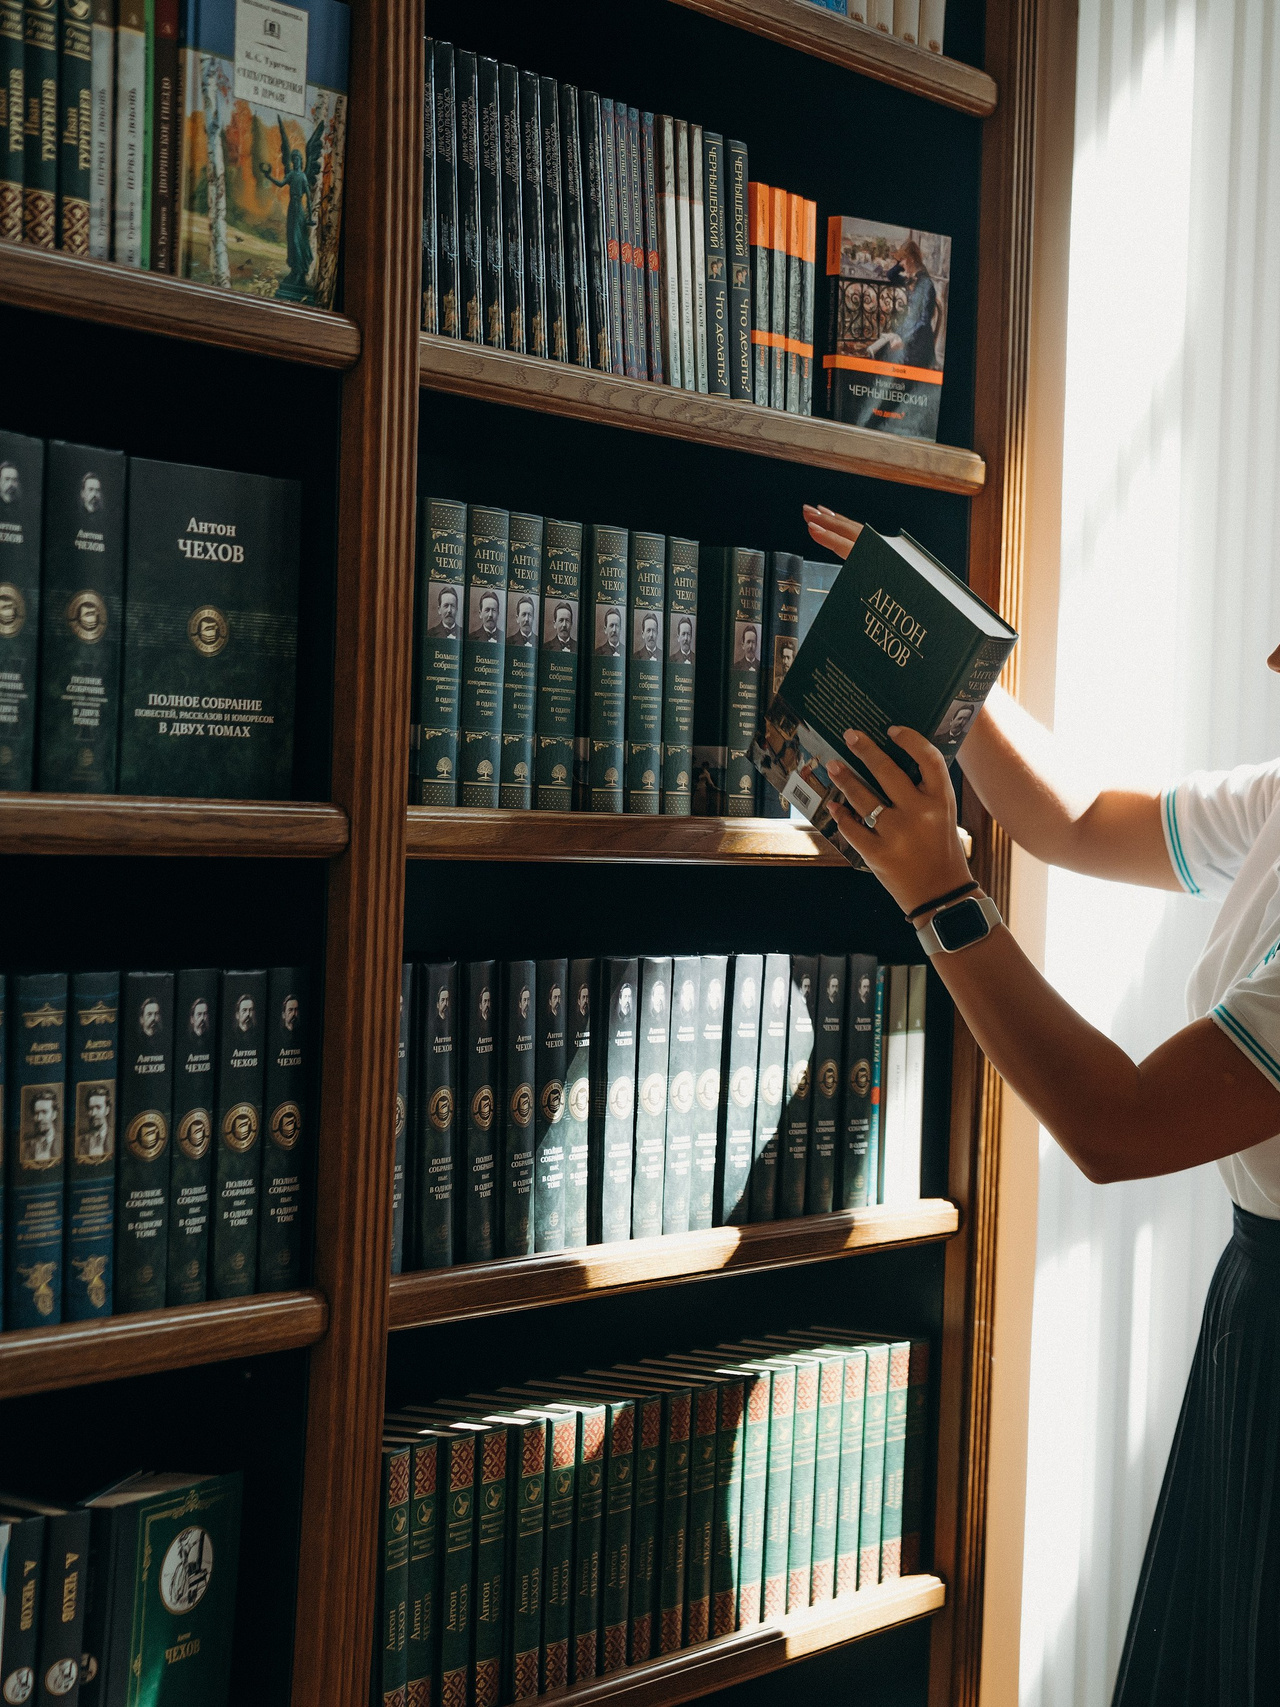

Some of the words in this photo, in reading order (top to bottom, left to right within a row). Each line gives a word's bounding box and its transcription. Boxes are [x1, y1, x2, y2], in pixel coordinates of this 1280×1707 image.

[9, 67, 24, 152] ТУРГЕНЕВ
[41, 77, 56, 162] ТУРГЕНЕВ
[708, 146, 720, 248] ЧЕРНЫШЕВСКИЙ
[734, 156, 744, 257] ЧЕРНЫШЕВСКИЙ
[715, 290, 726, 320] Что
[740, 299, 749, 326] Что
[715, 323, 728, 388] делать?
[740, 329, 751, 394] делать?
[848, 384, 928, 407] ЧЕРНЫШЕВСКИЙ
[876, 378, 906, 391] Николай
[186, 517, 236, 538] Антон
[177, 538, 244, 564] ЧЕХОВ
[433, 542, 464, 556] АНТОН
[474, 548, 506, 562] АНТОН
[435, 556, 462, 570] ЧЕХОВ
[476, 562, 504, 576] ЧЕХОВ
[549, 560, 578, 573] АНТОН
[551, 574, 578, 586] ЧЕХОВ
[868, 588, 928, 649] АНТОН
[864, 611, 912, 668] ЧЕХОВ
[148, 693, 200, 709] ПОЛНОЕ
[202, 697, 262, 712] СОБРАНИЕ
[179, 710, 222, 722] РАССКАЗОВ
[158, 722, 168, 734] В
[170, 722, 204, 737] ДВУХ
[208, 724, 251, 738] ТОМАХ
[874, 1014, 882, 1062] РАССКАЗЫ
[459, 1584, 468, 1632] ЧЕХОВ
[398, 1601, 406, 1652] ЧЕХОВ
[165, 1638, 200, 1665] ЧЕХОВ
